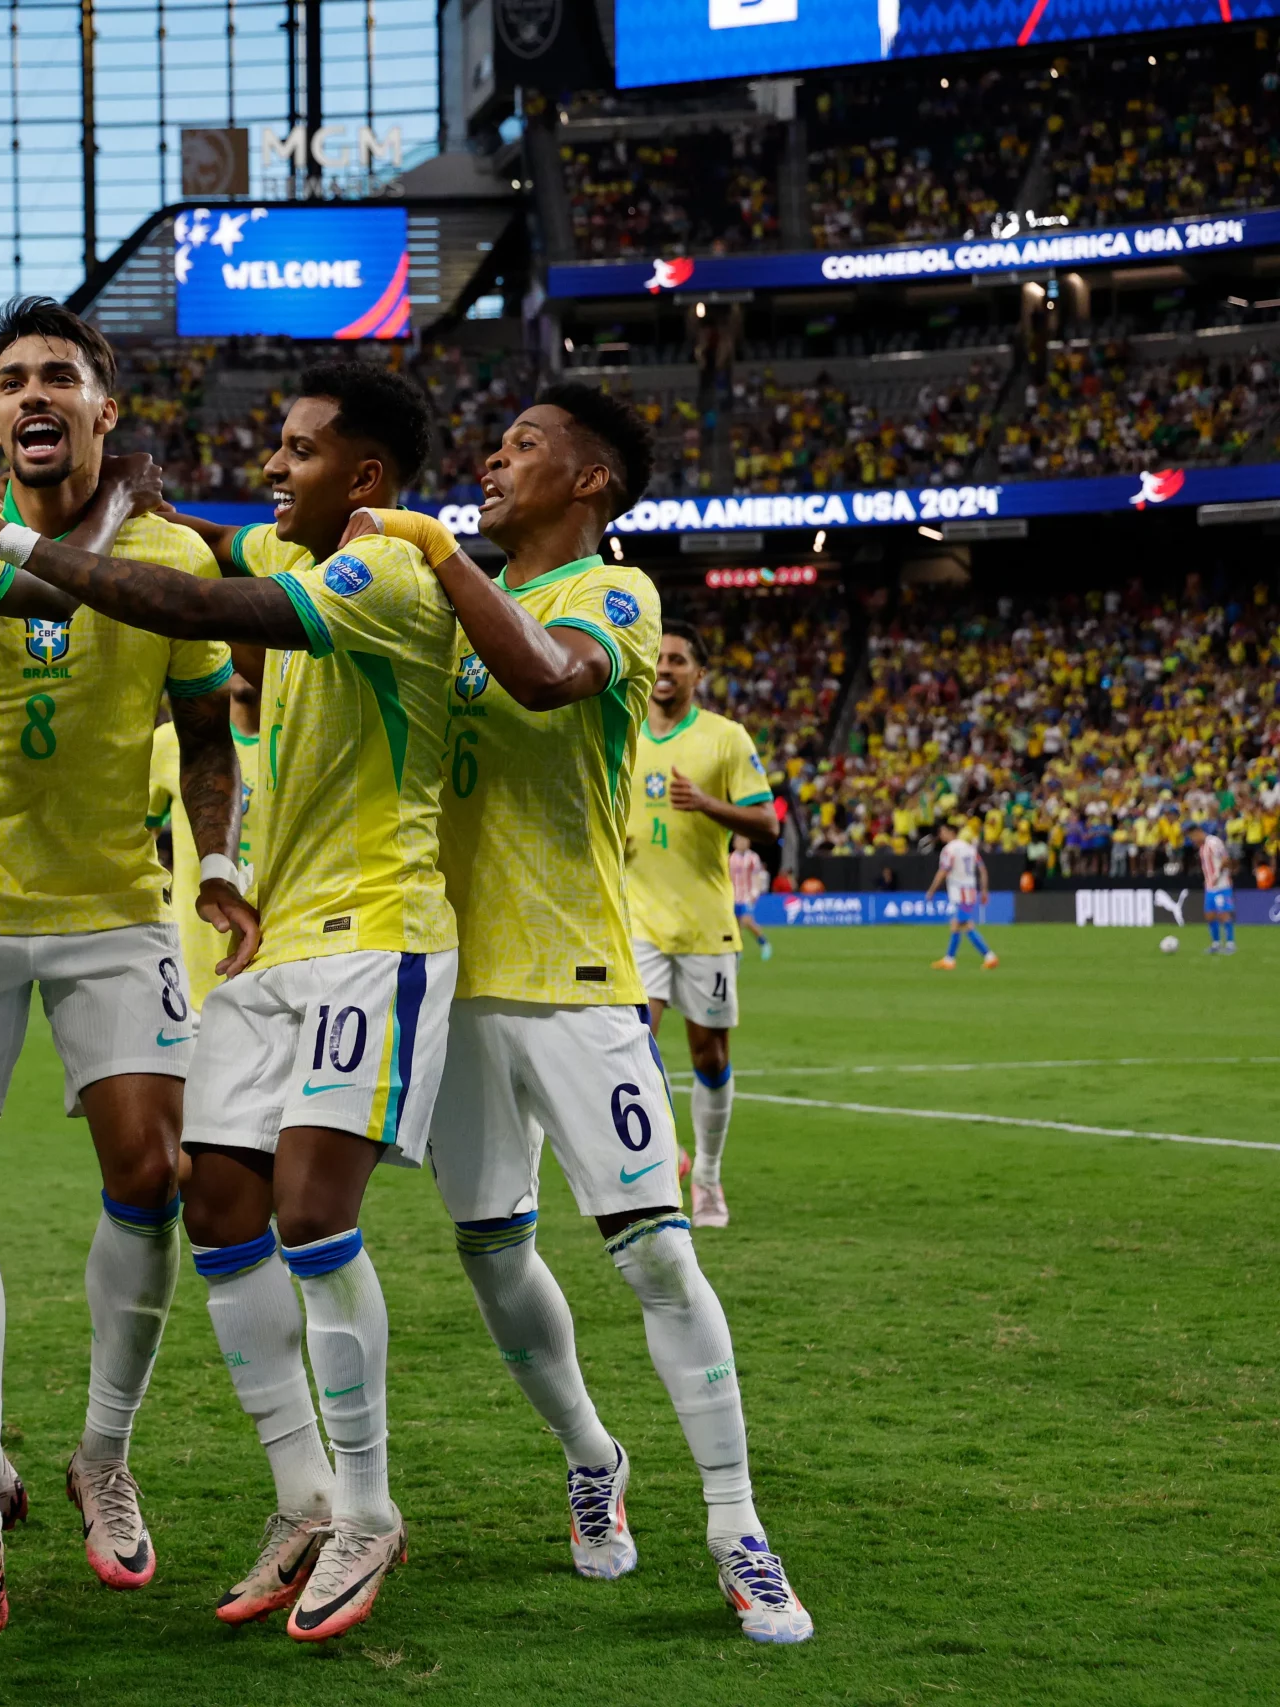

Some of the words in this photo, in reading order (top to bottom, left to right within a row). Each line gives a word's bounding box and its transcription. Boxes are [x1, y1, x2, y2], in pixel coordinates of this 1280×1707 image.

[262, 125, 402, 168] MGM
[821, 247, 954, 279] CONMEBOL
[954, 241, 1020, 269] COPA
[1020, 231, 1131, 264] AMERICA
[1134, 226, 1183, 254] USA
[1184, 219, 1244, 248] 2024
[221, 260, 362, 290] WELCOME
[624, 496, 702, 532] COPA
[701, 488, 847, 528] AMERICA
[853, 486, 915, 522] USA
[917, 478, 998, 516] 2024
[335, 561, 363, 586] VIBRA
[609, 596, 636, 618] VIBRA
[38, 629, 57, 638] CBF
[23, 668, 72, 679] BRASIL
[466, 668, 481, 676] CBF
[20, 693, 57, 760] 8
[451, 705, 488, 717] BRASIL
[452, 730, 479, 799] 6
[651, 817, 668, 849] 4
[802, 897, 862, 914] LATAM
[900, 900, 957, 917] DELTA
[1076, 888, 1153, 927] PUMA
[158, 957, 188, 1023] 8
[712, 971, 728, 1002] 4
[312, 1004, 367, 1073] 10
[610, 1082, 652, 1152] 6
